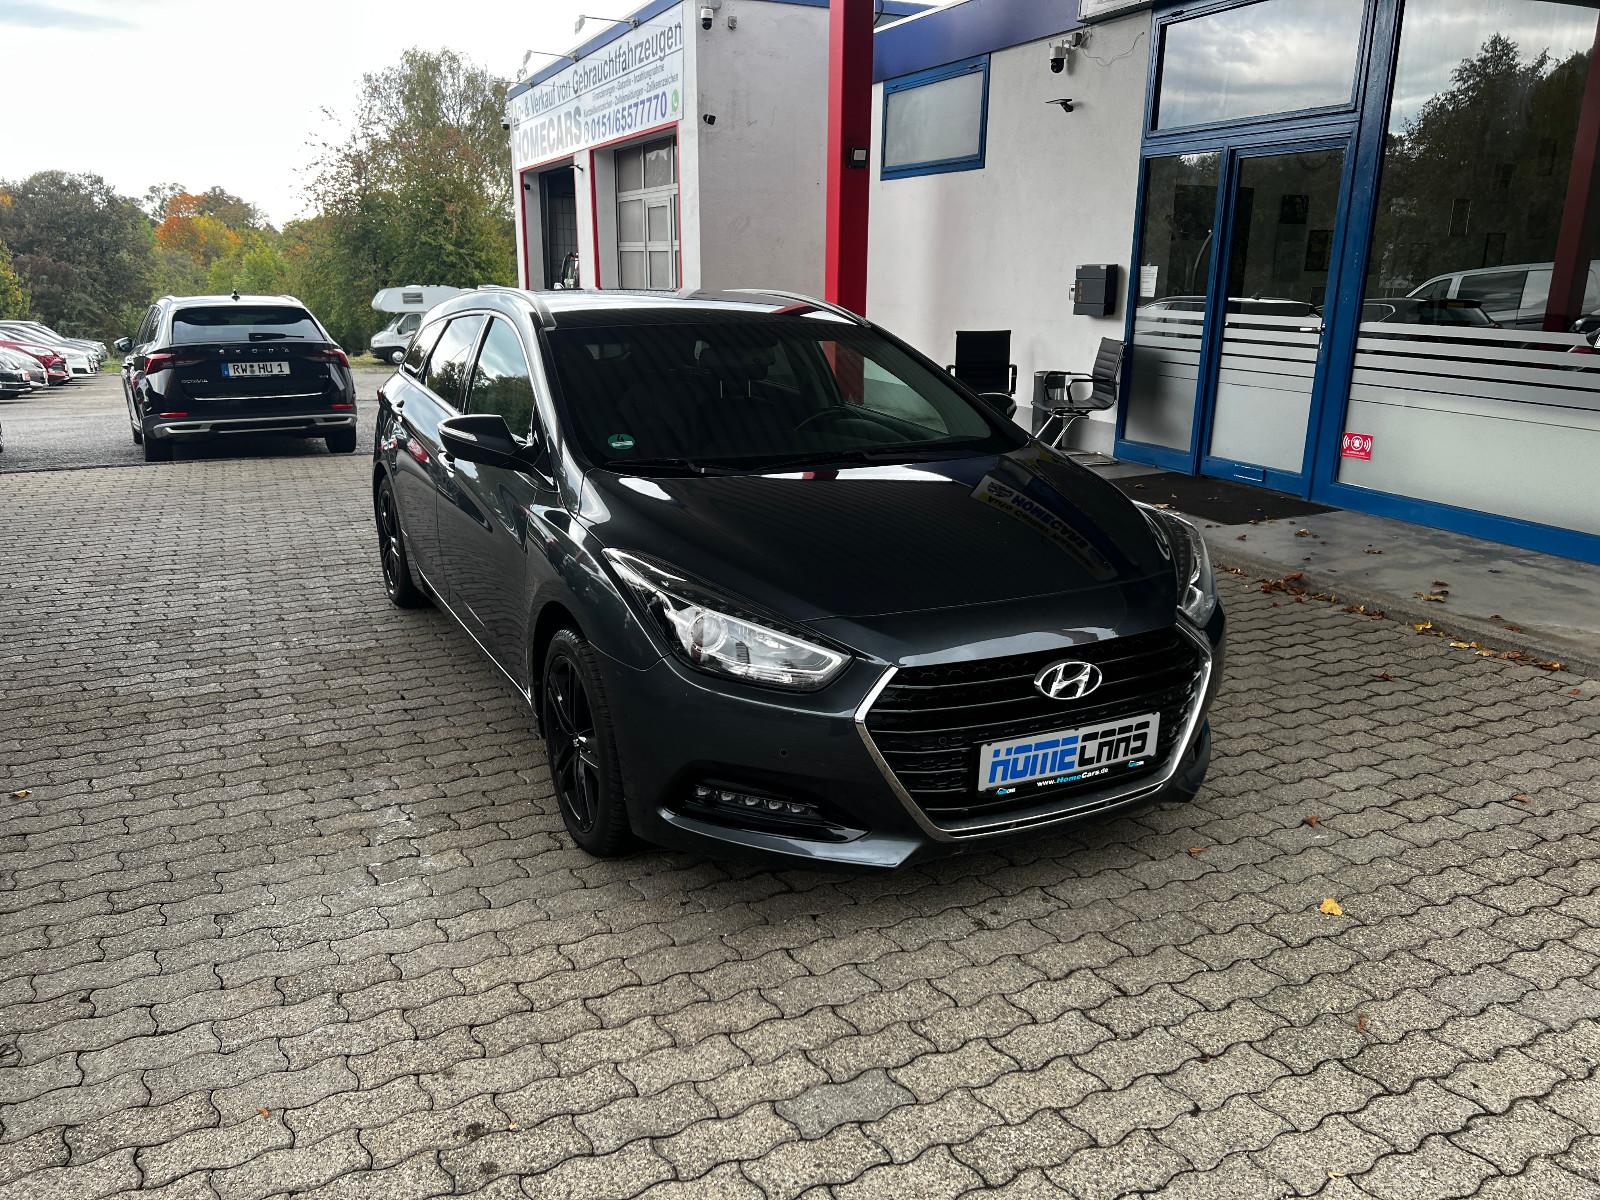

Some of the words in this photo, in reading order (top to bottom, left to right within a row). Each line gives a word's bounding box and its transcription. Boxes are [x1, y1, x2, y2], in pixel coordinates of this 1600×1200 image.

[530, 81, 556, 115] Verkauf
[557, 79, 571, 102] von
[572, 22, 682, 95] Gebrauchtfahrzeugen
[512, 106, 582, 166] HOMECARS
[591, 91, 667, 140] 0151/65577770
[233, 364, 248, 375] RW
[257, 363, 273, 374] HU
[277, 362, 285, 373] 1
[1036, 766, 1109, 788] www.HomeCars.de
